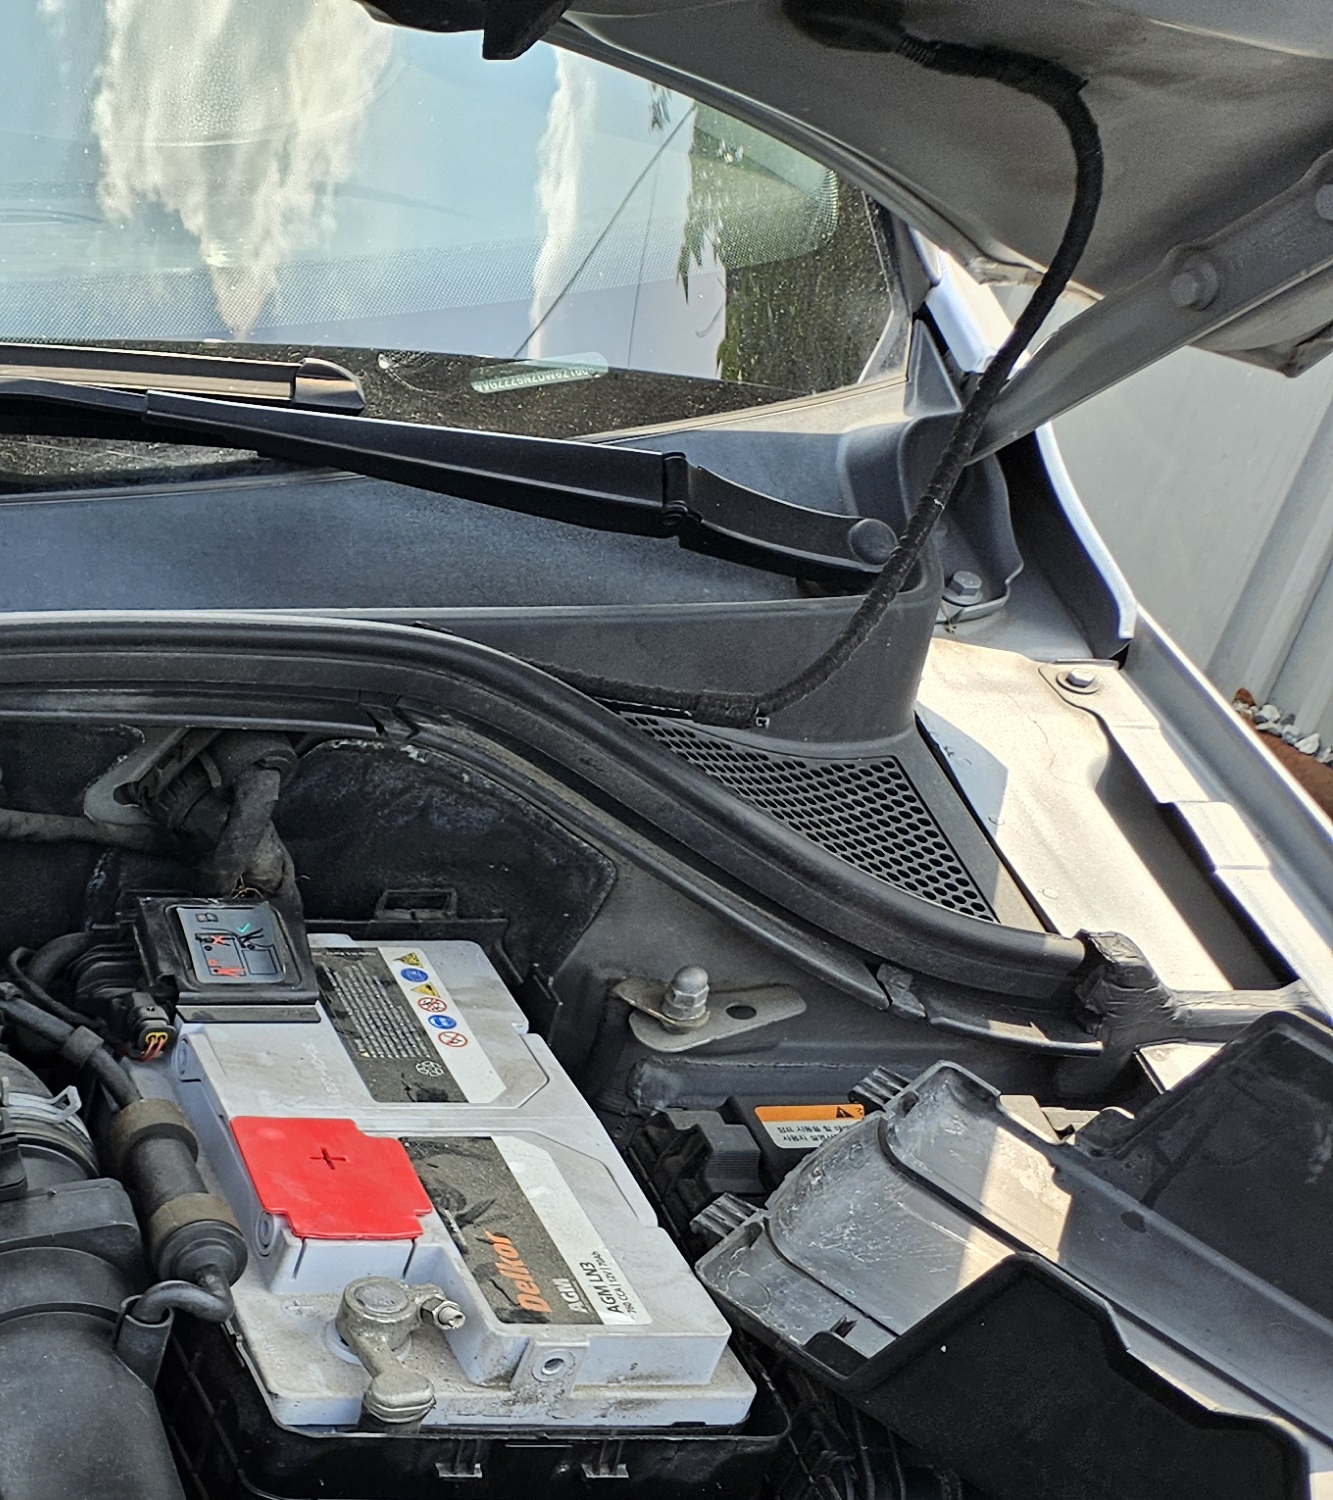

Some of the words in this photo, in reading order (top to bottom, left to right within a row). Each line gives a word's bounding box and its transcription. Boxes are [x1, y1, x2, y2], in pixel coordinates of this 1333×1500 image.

[483, 1228, 552, 1313] Delkor
[580, 1262, 604, 1282] LN3
[552, 1278, 590, 1313] AGM
[593, 1285, 624, 1314] AGM
